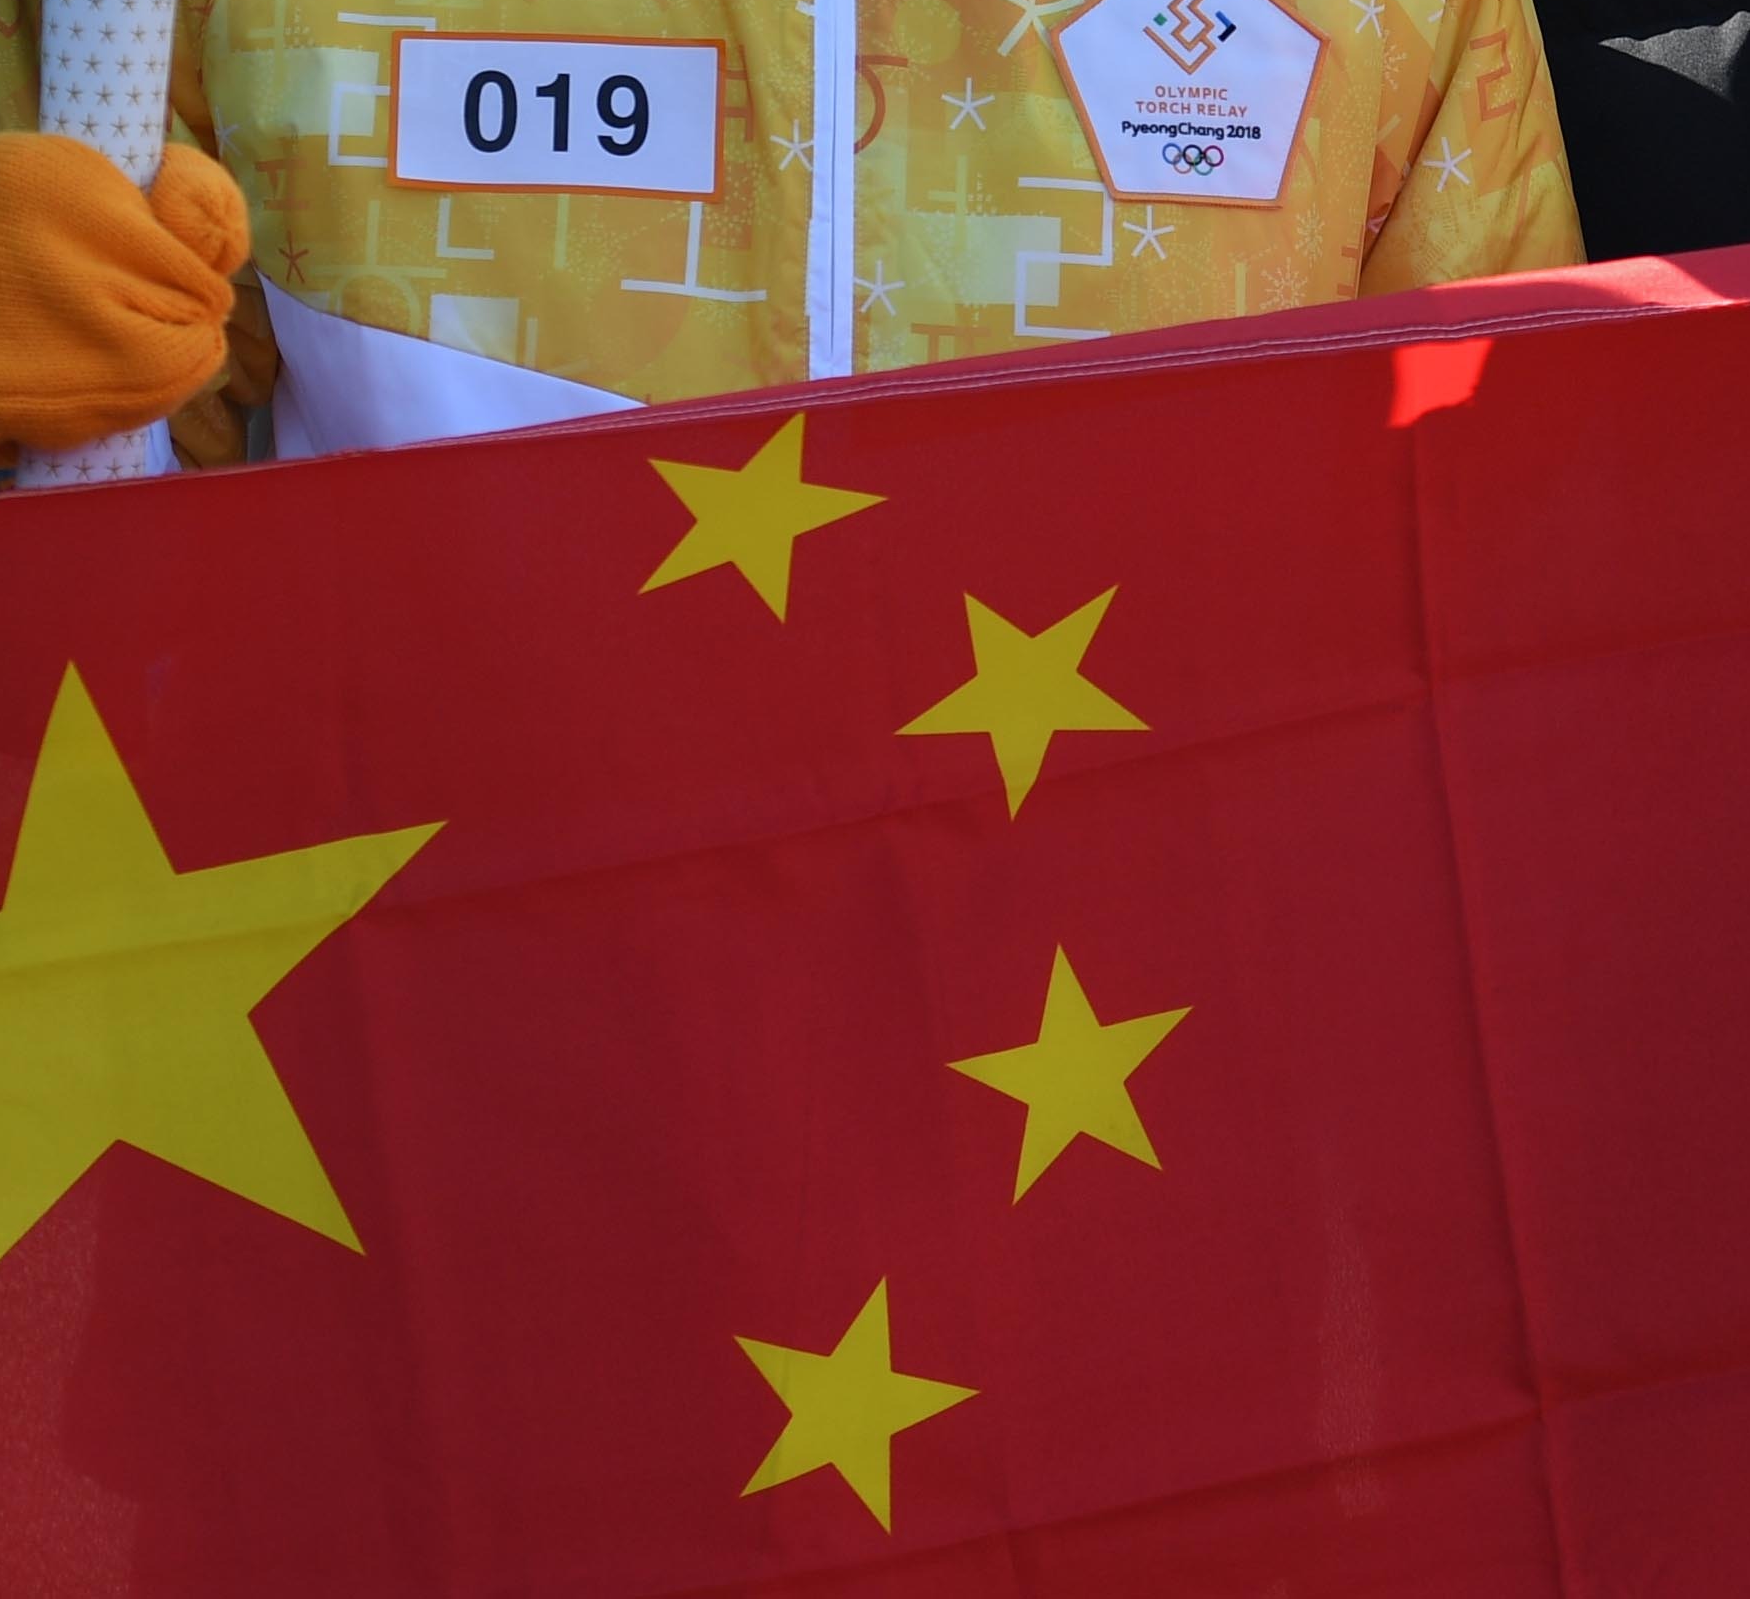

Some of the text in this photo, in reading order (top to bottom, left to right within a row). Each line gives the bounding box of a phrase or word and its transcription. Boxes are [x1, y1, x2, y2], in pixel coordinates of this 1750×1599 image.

[1155, 86, 1227, 100] OLYMPIC
[463, 69, 650, 157] 019
[1135, 101, 1247, 118] TORCH RELAY
[1121, 120, 1261, 141] PyeongChang 2018
